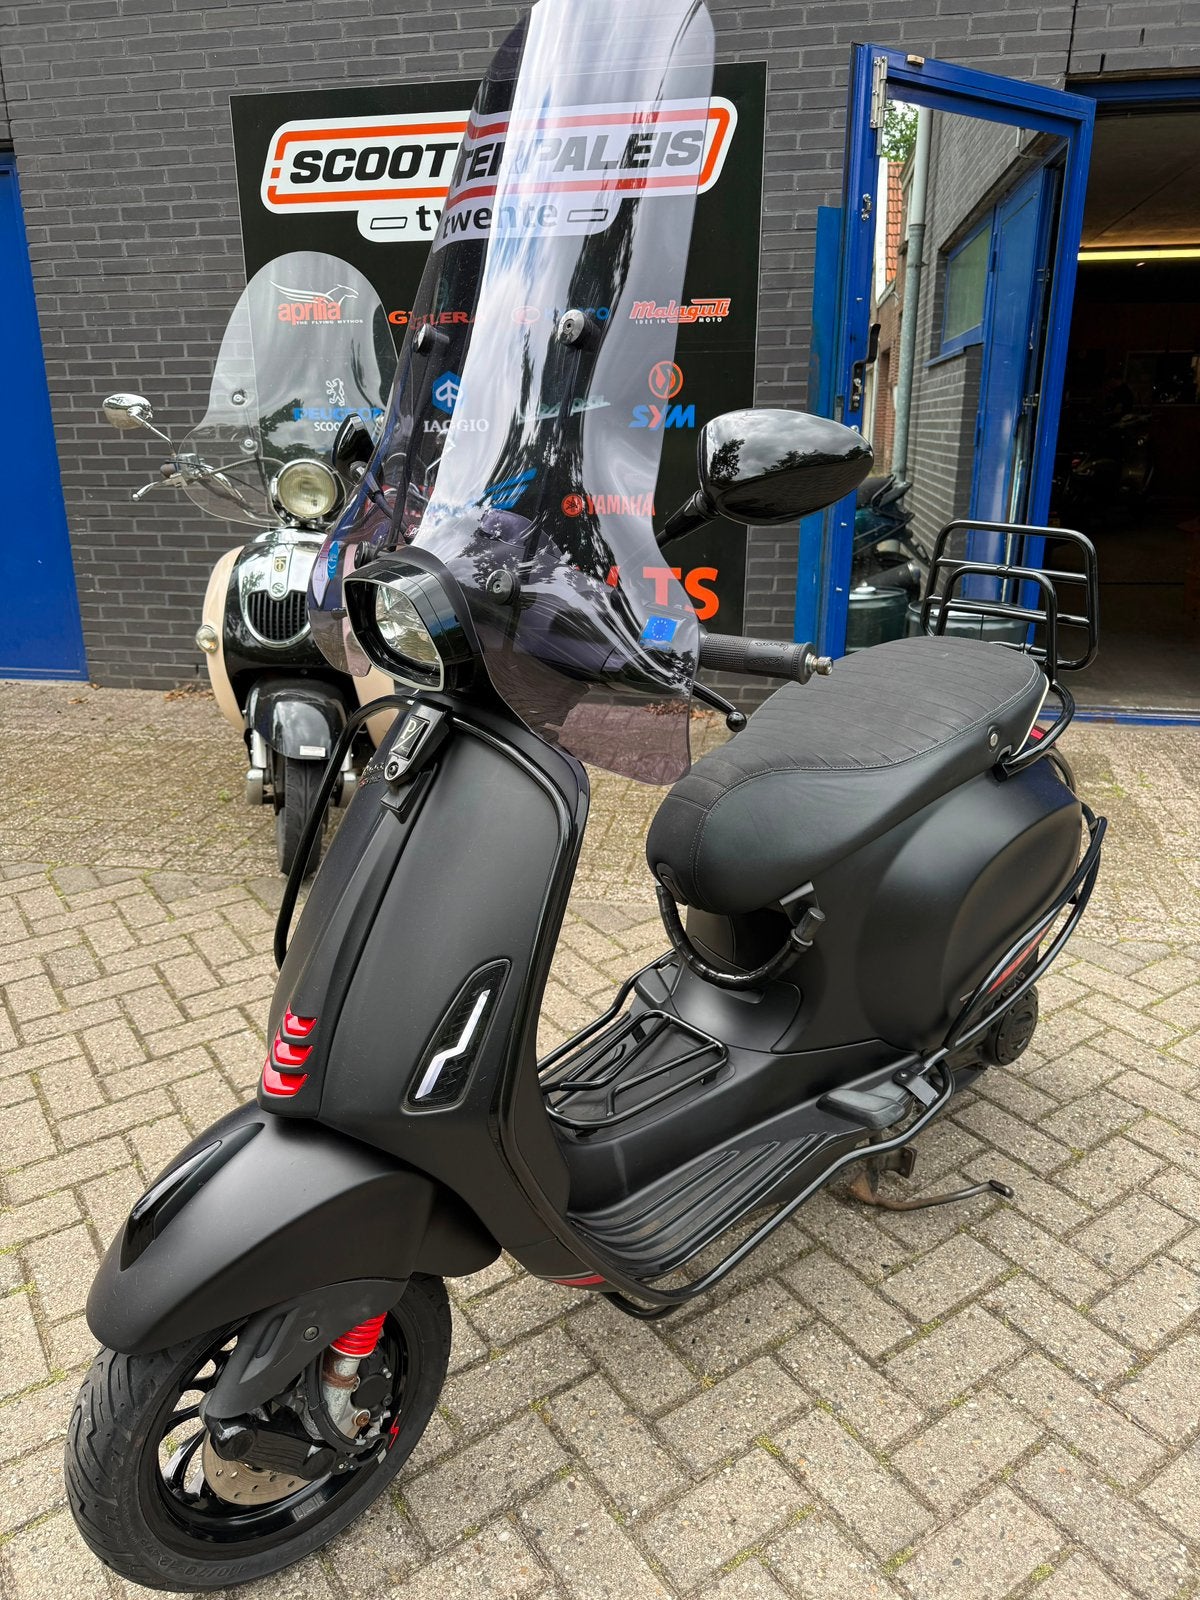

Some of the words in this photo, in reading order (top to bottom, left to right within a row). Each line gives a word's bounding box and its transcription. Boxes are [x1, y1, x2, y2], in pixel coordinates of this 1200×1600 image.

[278, 297, 341, 325] aprilia
[629, 298, 732, 324] Malaguti
[423, 418, 489, 433] IAGGIO
[628, 404, 696, 431] SYM
[585, 493, 656, 517] YAMAHA
